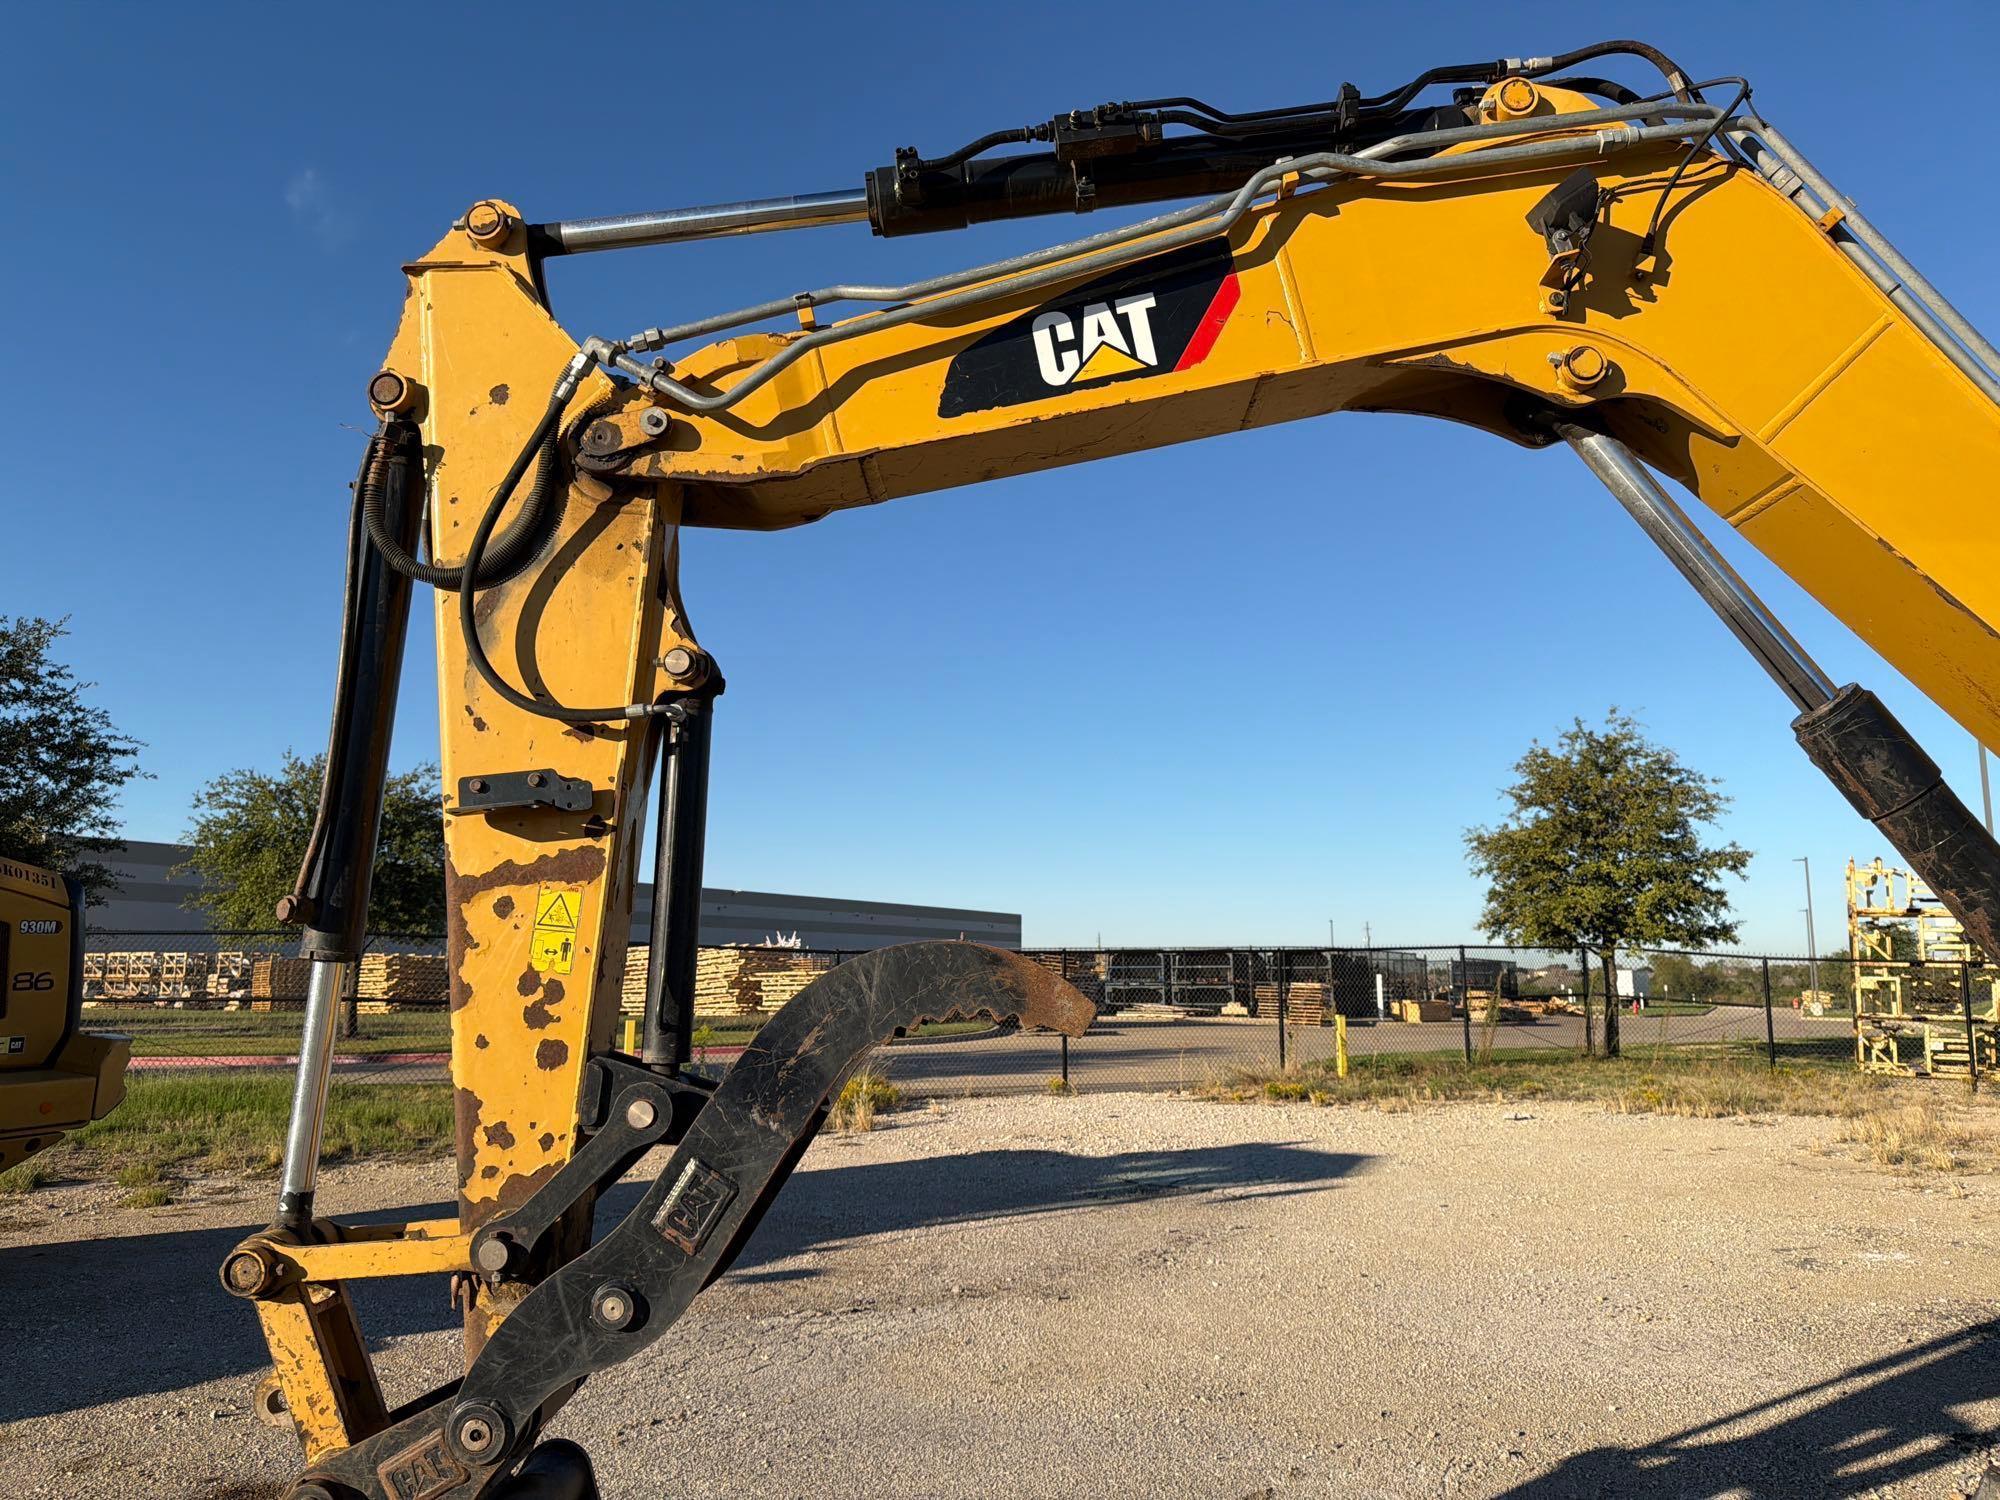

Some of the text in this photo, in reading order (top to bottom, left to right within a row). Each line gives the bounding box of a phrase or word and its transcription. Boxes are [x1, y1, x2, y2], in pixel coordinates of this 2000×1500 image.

[1031, 291, 1158, 387] CAT
[0, 863, 56, 889] K01351
[20, 920, 57, 934] 930M
[12, 971, 55, 991] 86
[10, 1041, 23, 1049] CAT
[668, 1174, 721, 1240] CAT
[391, 1445, 449, 1500] CAT
